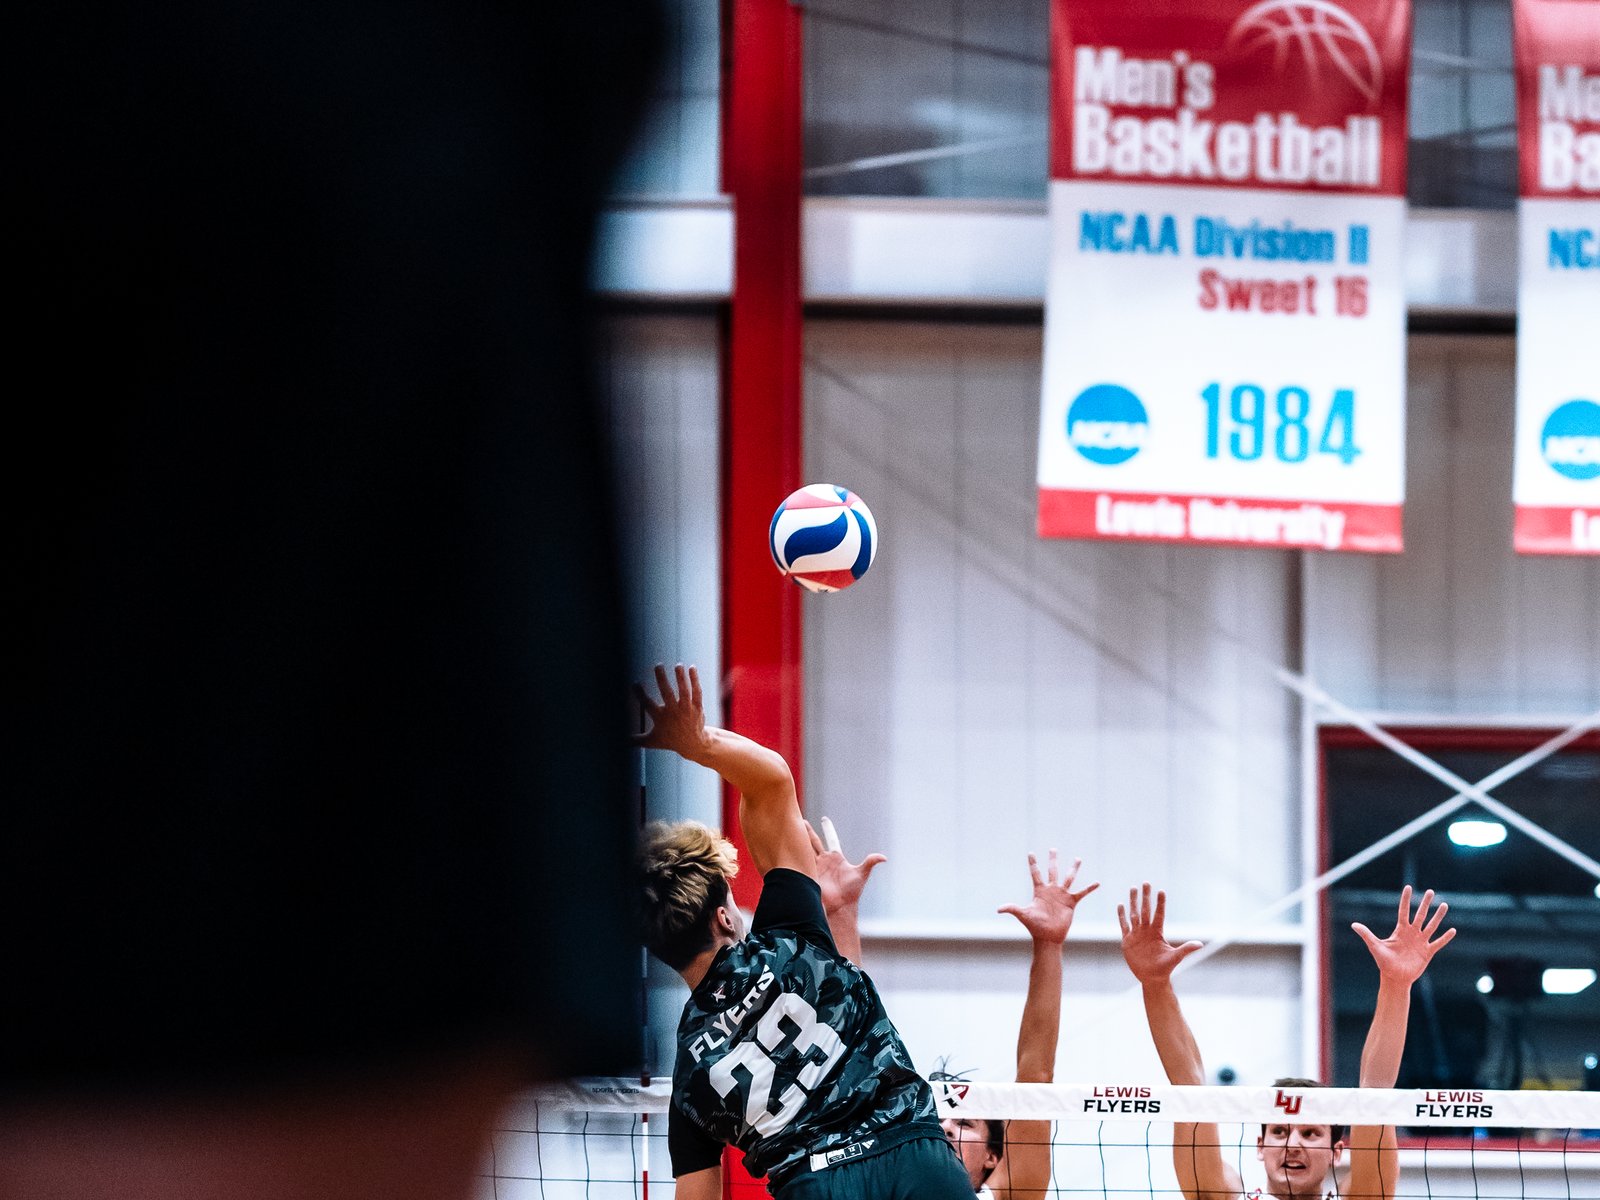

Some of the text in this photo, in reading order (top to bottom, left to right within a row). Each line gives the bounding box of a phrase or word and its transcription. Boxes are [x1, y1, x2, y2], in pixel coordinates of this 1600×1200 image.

[1073, 45, 1215, 110] Men's
[1073, 104, 1381, 186] Basketball
[1078, 211, 1370, 265] NCAA Division II
[1548, 227, 1600, 270] NC
[1198, 268, 1368, 318] Sweet 16
[1200, 381, 1362, 465] 1984
[1096, 493, 1346, 550] Lewis University
[688, 964, 775, 1063] FLYERS
[709, 992, 848, 1139] 23
[1093, 1086, 1151, 1098] LEWIS
[1083, 1099, 1161, 1114] FLYERS
[1415, 1104, 1493, 1119] FLYERS
[1425, 1091, 1484, 1103] LEWIS
